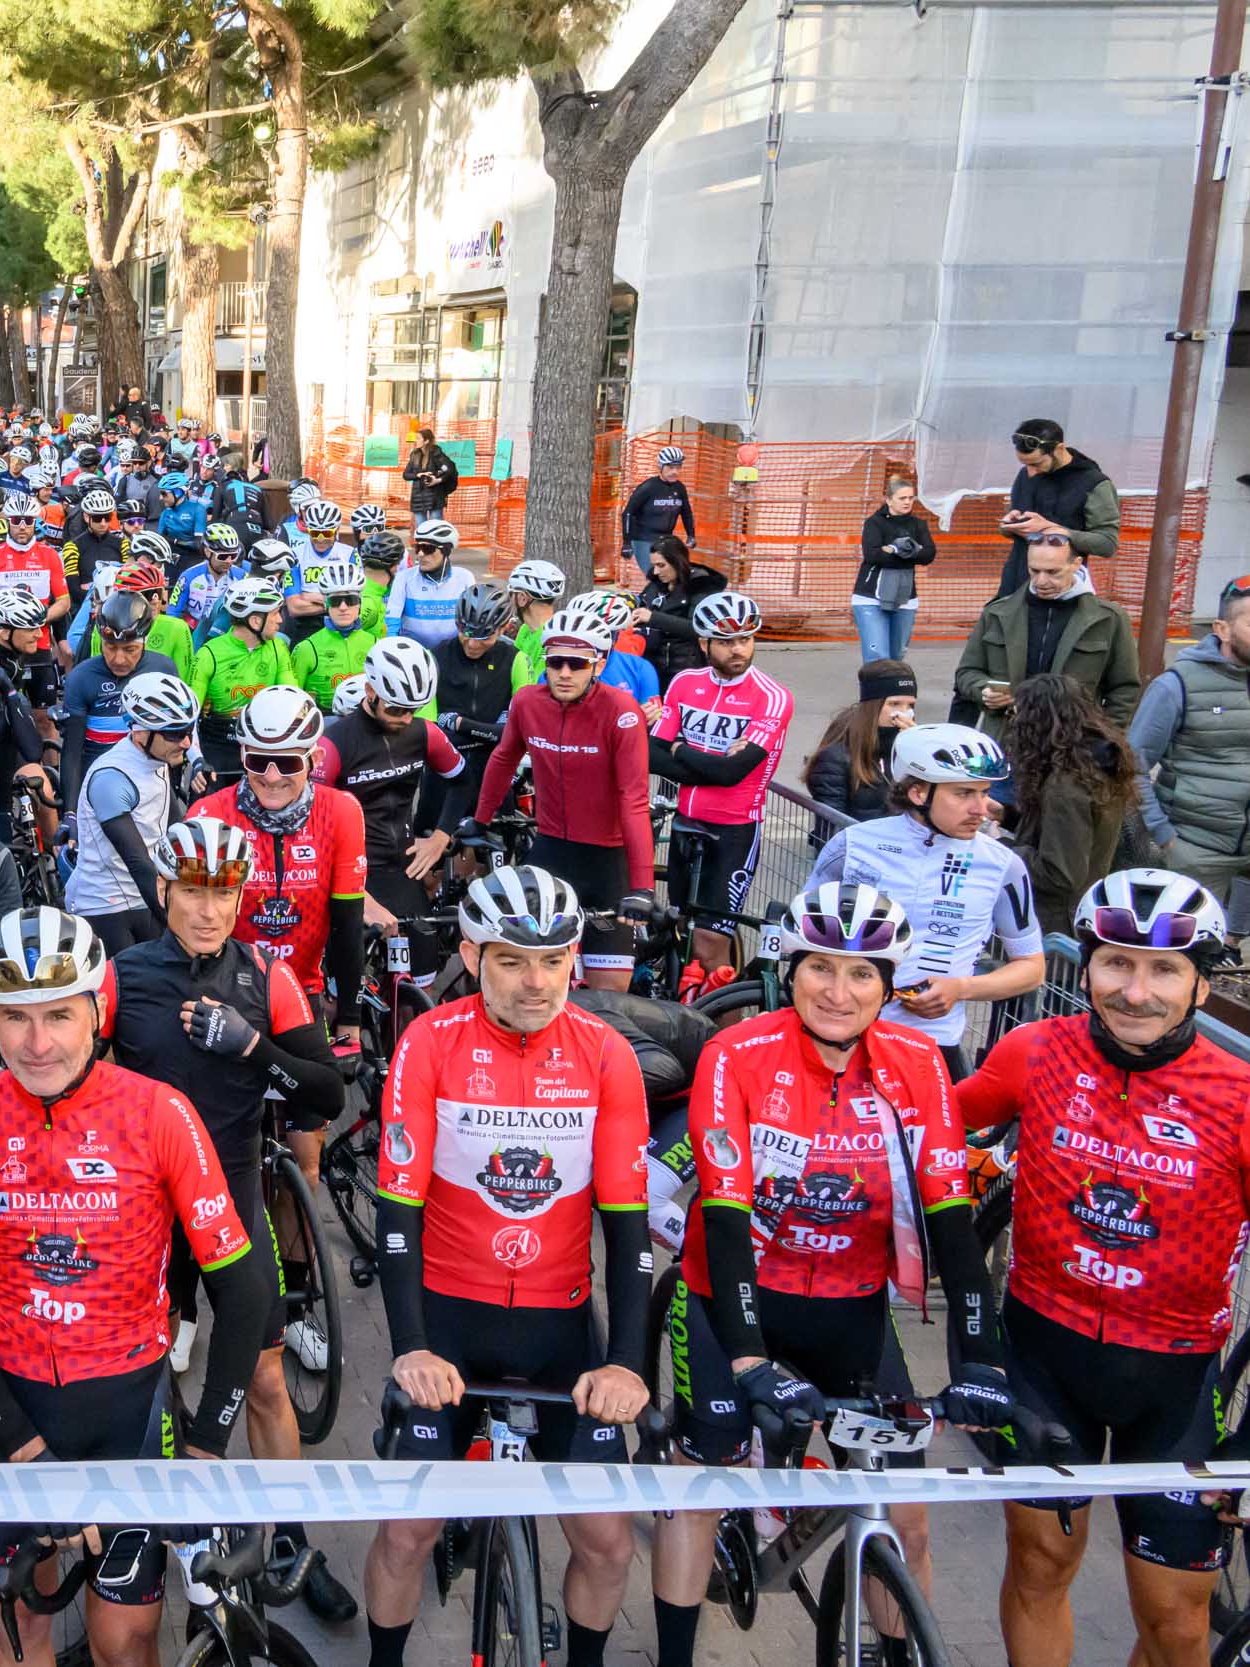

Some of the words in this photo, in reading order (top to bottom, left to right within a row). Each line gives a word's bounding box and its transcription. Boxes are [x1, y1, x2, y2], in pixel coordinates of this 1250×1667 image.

[678, 704, 750, 740] MARY
[762, 936, 780, 952] 18
[390, 948, 409, 963] 40
[280, 966, 311, 1024] BONTRAGER
[206, 1008, 222, 1047] Capitano
[431, 1010, 476, 1029] TREK
[732, 1031, 784, 1050] TREK
[393, 1038, 411, 1117] TREK
[534, 1076, 554, 1085] Team
[712, 1051, 729, 1124] TREK
[534, 1085, 590, 1102] Capitano
[476, 1109, 583, 1128] DELTACOM
[168, 1096, 208, 1176] BONTRAGER
[456, 1127, 487, 1138] Idraulica
[78, 1144, 109, 1153] FORMA
[929, 1147, 967, 1168] Top
[1070, 1130, 1195, 1178] DELTACOM
[484, 1175, 555, 1191] PEPPERBIKE
[11, 1191, 118, 1210] DELTACOM
[713, 1189, 748, 1201] FORMA
[192, 1193, 227, 1220] Top
[1073, 1204, 1151, 1236] PEPPERBIKE
[787, 1224, 853, 1254] Top
[1072, 1244, 1143, 1289] Top
[29, 1288, 86, 1325] Top
[847, 1426, 919, 1446] 151
